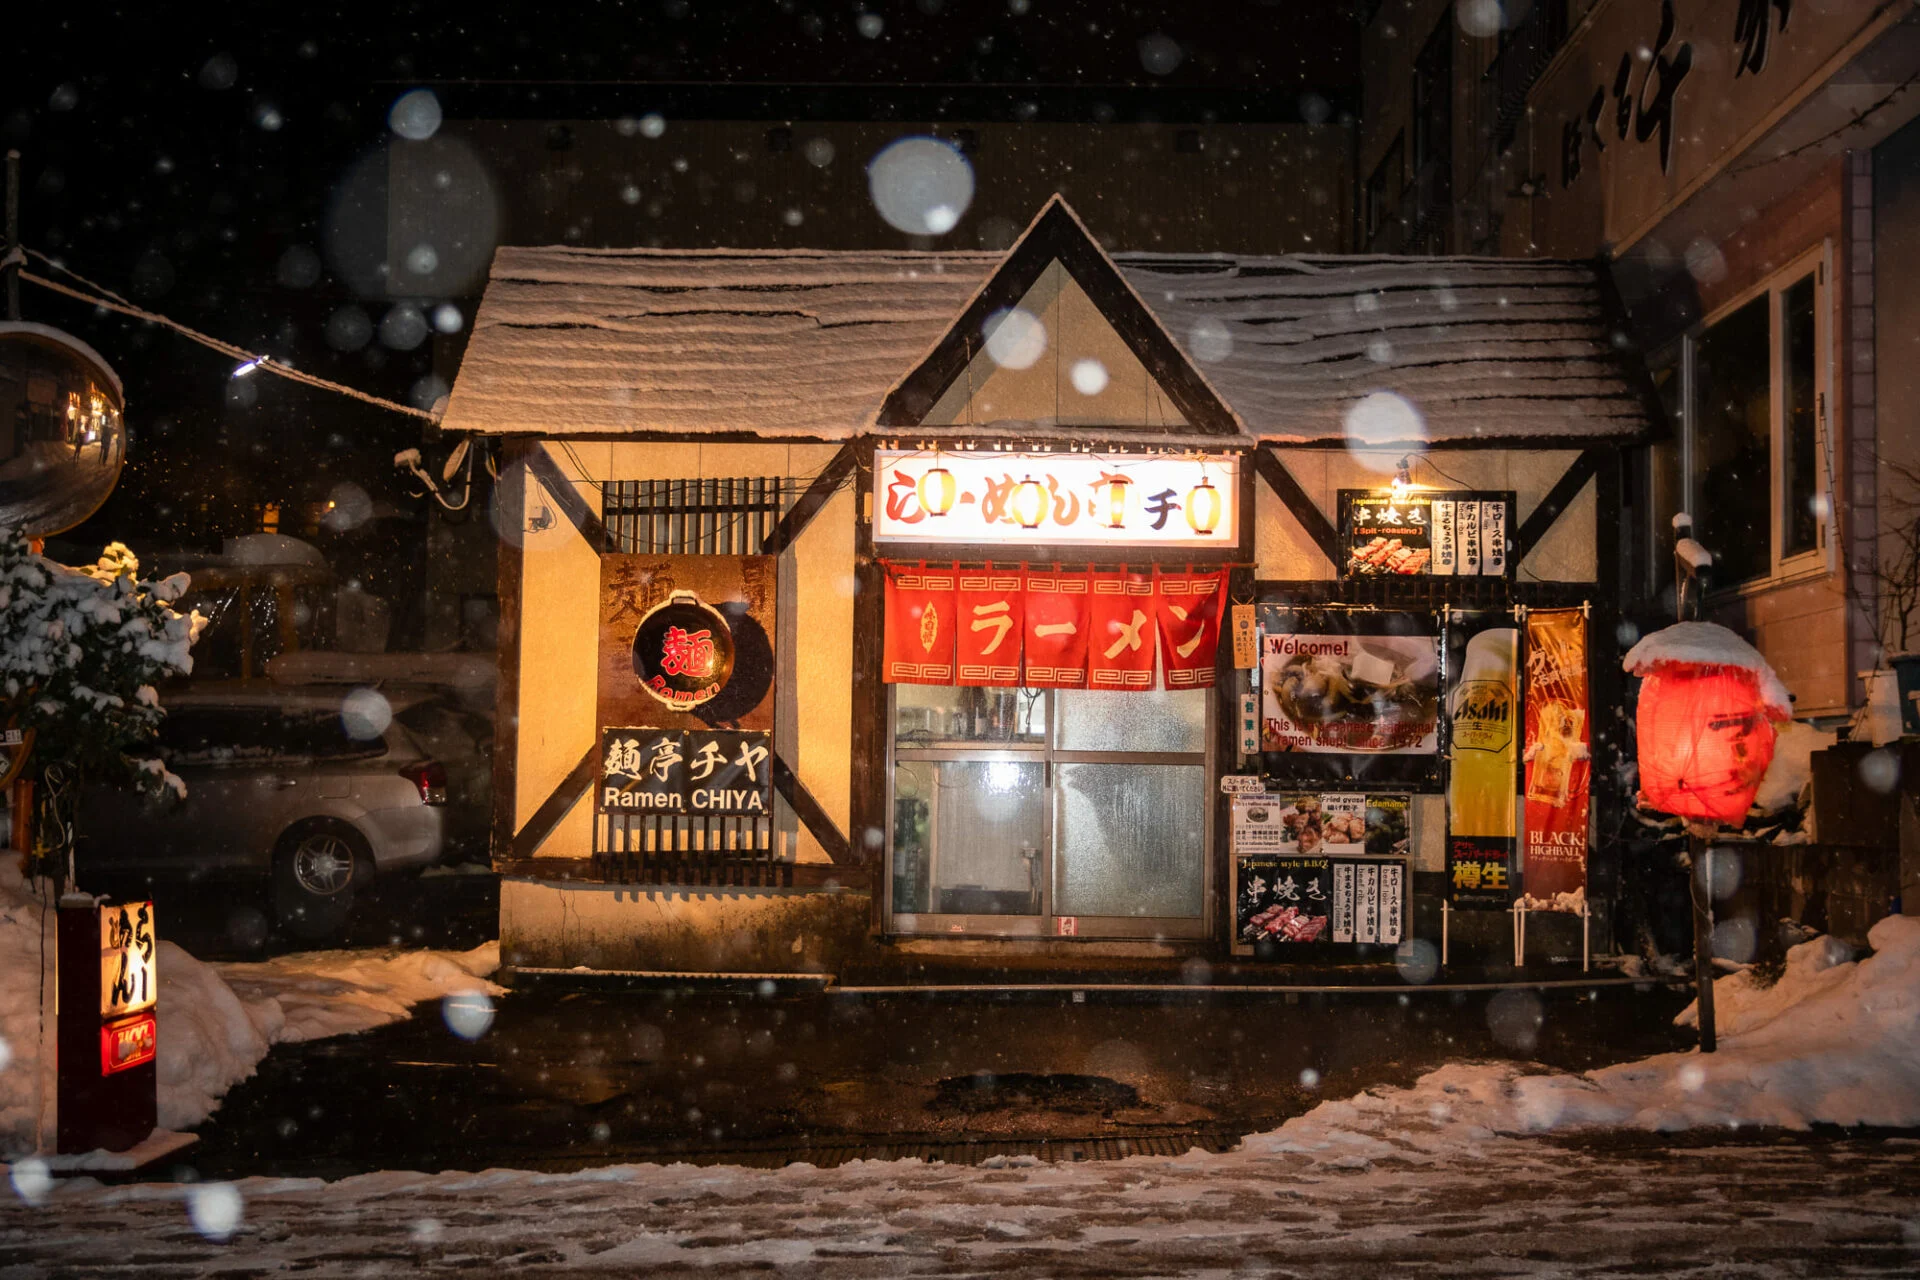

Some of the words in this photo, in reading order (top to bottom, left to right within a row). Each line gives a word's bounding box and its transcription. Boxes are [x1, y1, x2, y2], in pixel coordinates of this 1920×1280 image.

[1353, 506, 1427, 526] 串焼き
[970, 600, 1206, 660] ラーメン
[659, 624, 715, 678] 麺
[1270, 639, 1348, 656] Welcome!
[647, 674, 721, 703] Ramen
[1454, 698, 1509, 723] Asahi
[1244, 701, 1254, 750] 営業中
[1267, 718, 1290, 732] This
[1276, 736, 1312, 746] ramen
[1391, 735, 1422, 748] 1972
[604, 787, 682, 808] Ramen
[692, 788, 764, 810] CHIYA
[1366, 799, 1407, 808] Edamame
[1530, 830, 1584, 846] BLACK
[1453, 849, 1508, 860] スーパードライ
[1530, 846, 1581, 857] HIGHBALL
[1242, 858, 1278, 870] Japanese
[1281, 860, 1301, 868] style
[1358, 868, 1366, 887] beef
[1382, 868, 1390, 888] beef
[1452, 860, 1509, 890] 樽生
[1247, 875, 1327, 903] 串焼き
[136, 903, 153, 1002] らー
